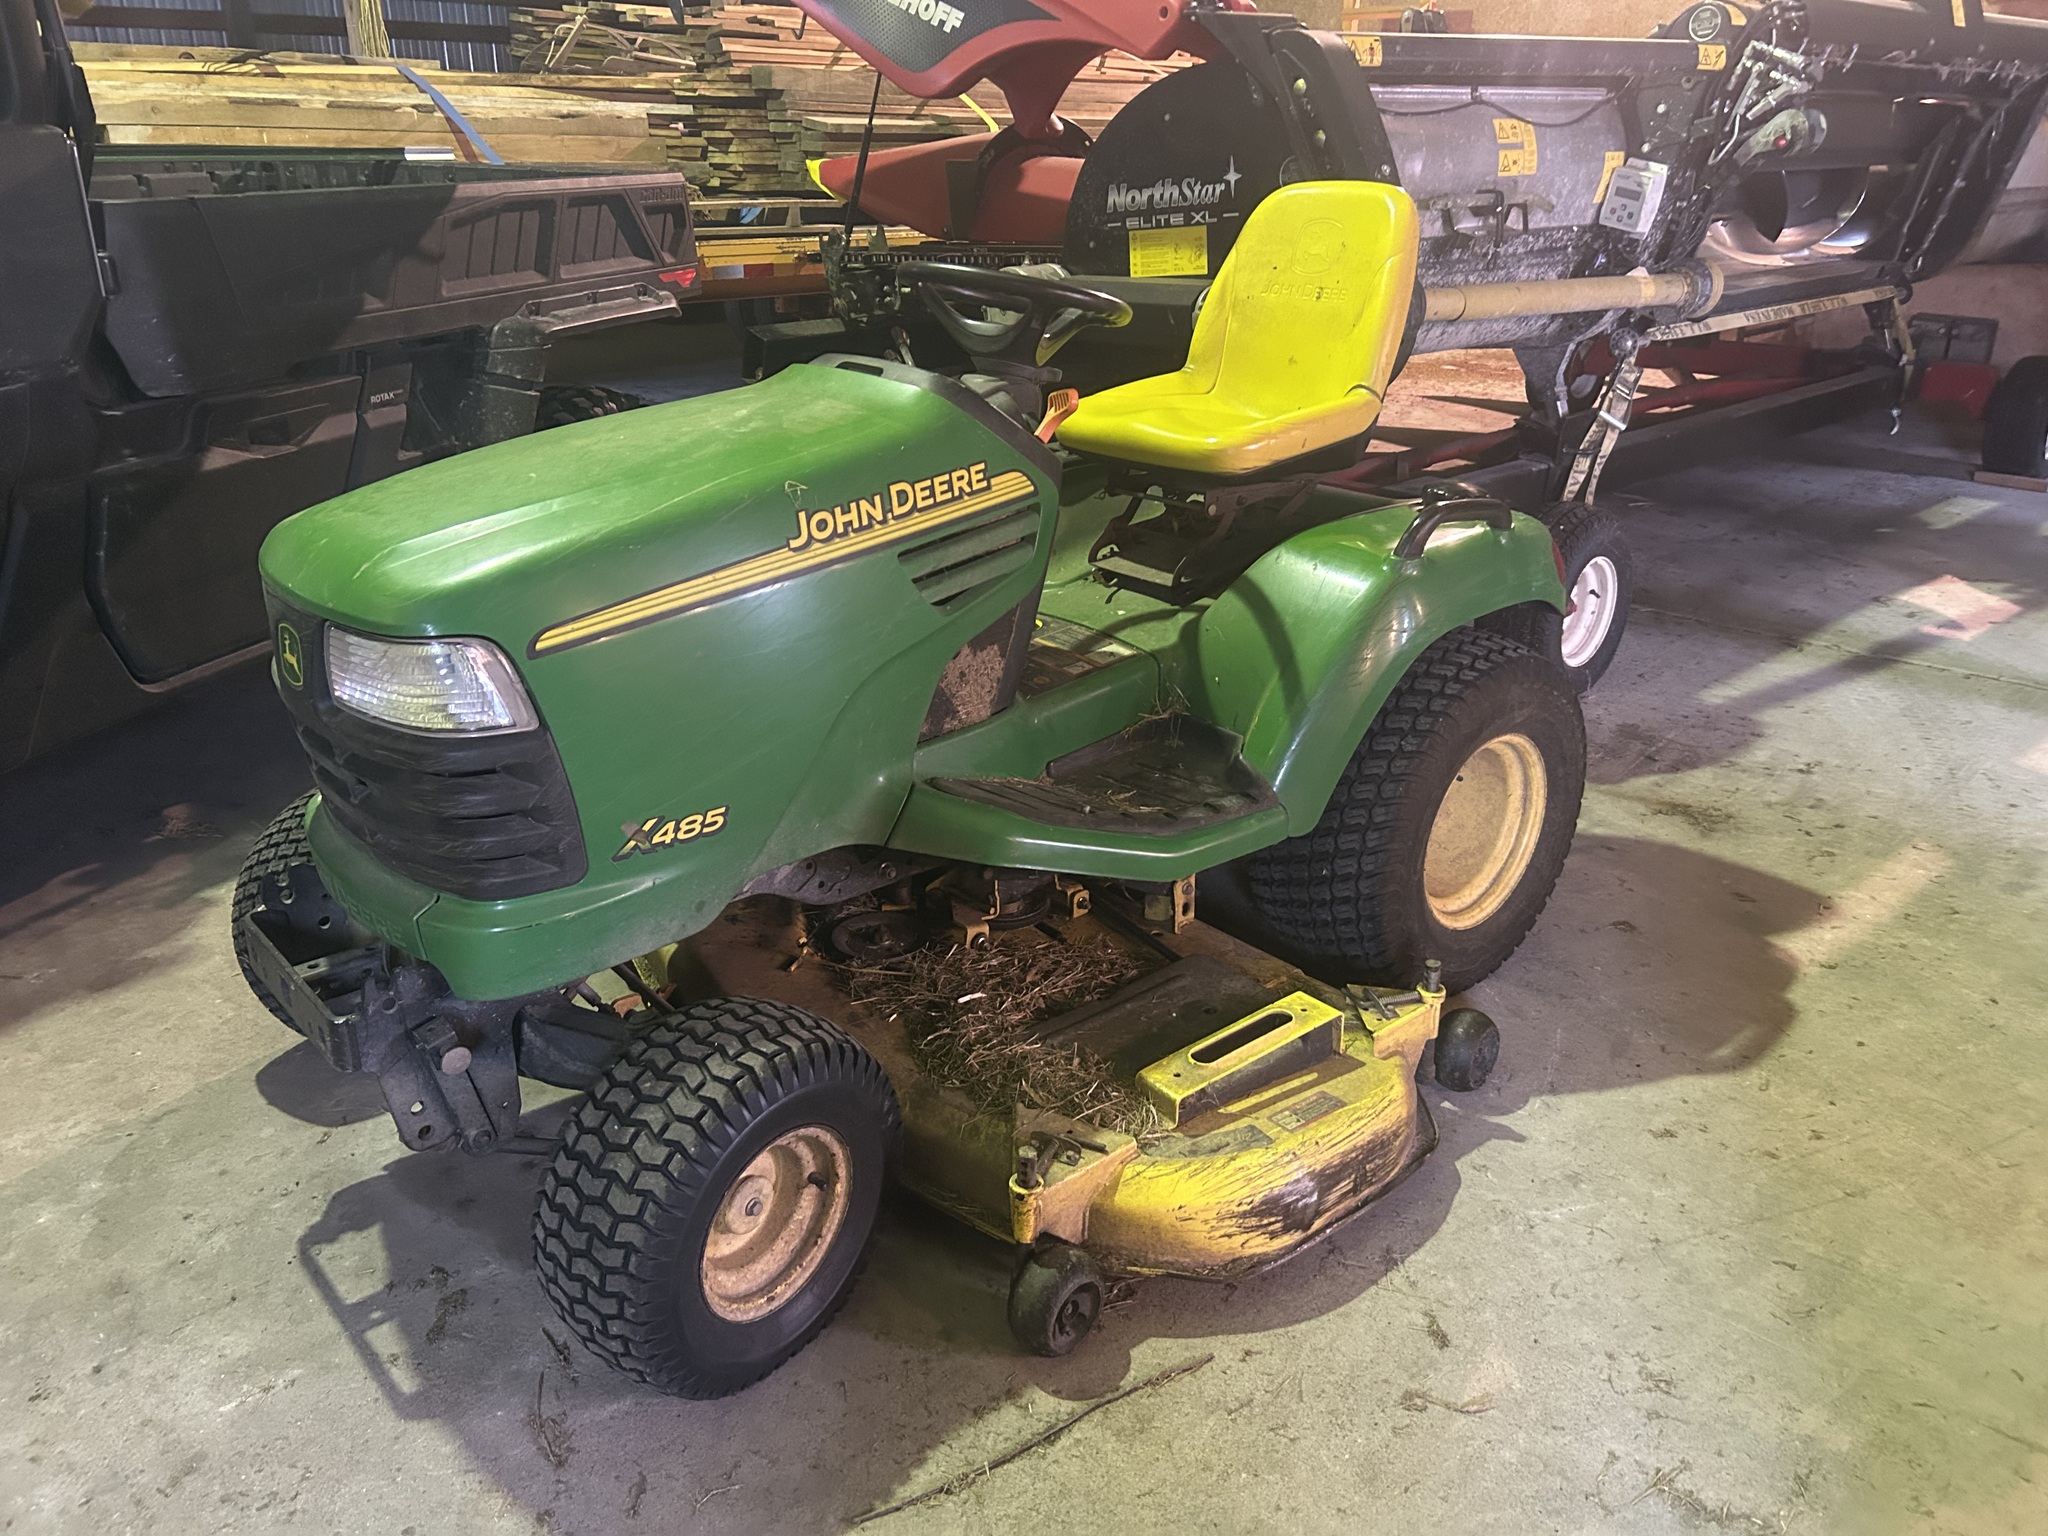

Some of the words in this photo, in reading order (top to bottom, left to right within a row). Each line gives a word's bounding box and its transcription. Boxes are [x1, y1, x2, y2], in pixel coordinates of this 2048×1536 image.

[888, 0, 966, 34] HOFF
[1106, 177, 1226, 213] NorthStar
[1126, 213, 1184, 230] ELITE
[1191, 210, 1218, 225] XL
[1260, 283, 1301, 299] JOHN
[370, 391, 395, 404] ROTAX
[788, 494, 886, 550] JOHN
[889, 461, 989, 518] DEERE
[612, 805, 728, 861] X485
